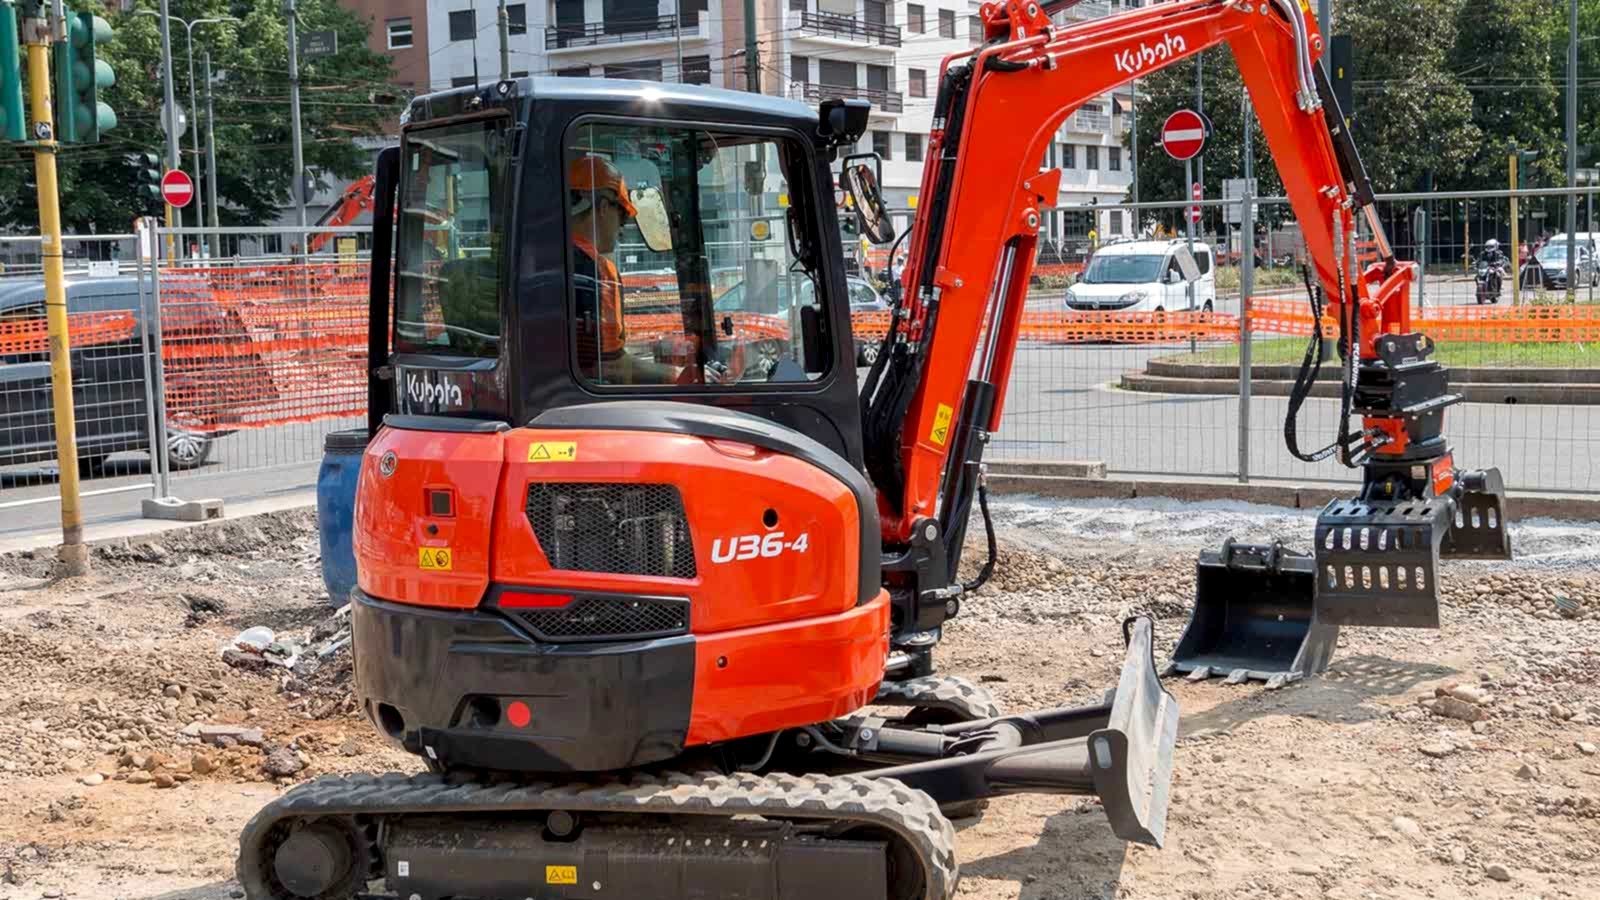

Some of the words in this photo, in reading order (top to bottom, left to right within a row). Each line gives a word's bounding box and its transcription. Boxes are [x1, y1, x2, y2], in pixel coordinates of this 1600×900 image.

[1114, 32, 1186, 74] Kubota
[406, 373, 463, 406] Kubota
[711, 531, 809, 564] U36-4
